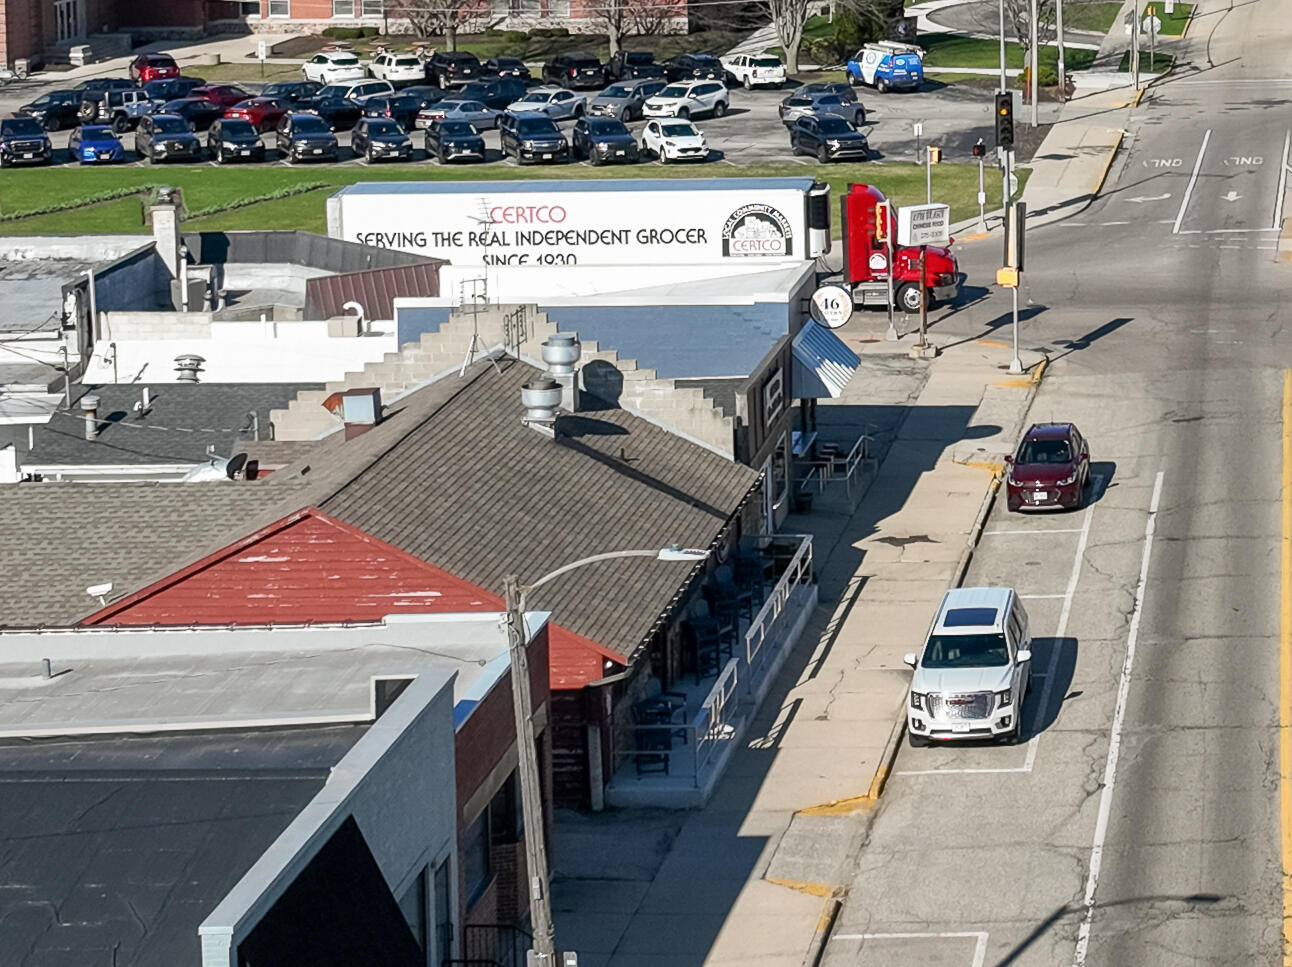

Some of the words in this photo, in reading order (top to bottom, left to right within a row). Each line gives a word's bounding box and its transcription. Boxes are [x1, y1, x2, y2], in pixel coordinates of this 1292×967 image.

[490, 206, 567, 224] CERTCO
[356, 232, 427, 249] SERVING
[432, 232, 463, 248] THE
[468, 232, 511, 248] REAL
[515, 229, 632, 246] INDEPENDENT
[636, 228, 708, 245] GROCER
[733, 239, 782, 251] CERTCO
[820, 298, 840, 310] 46
